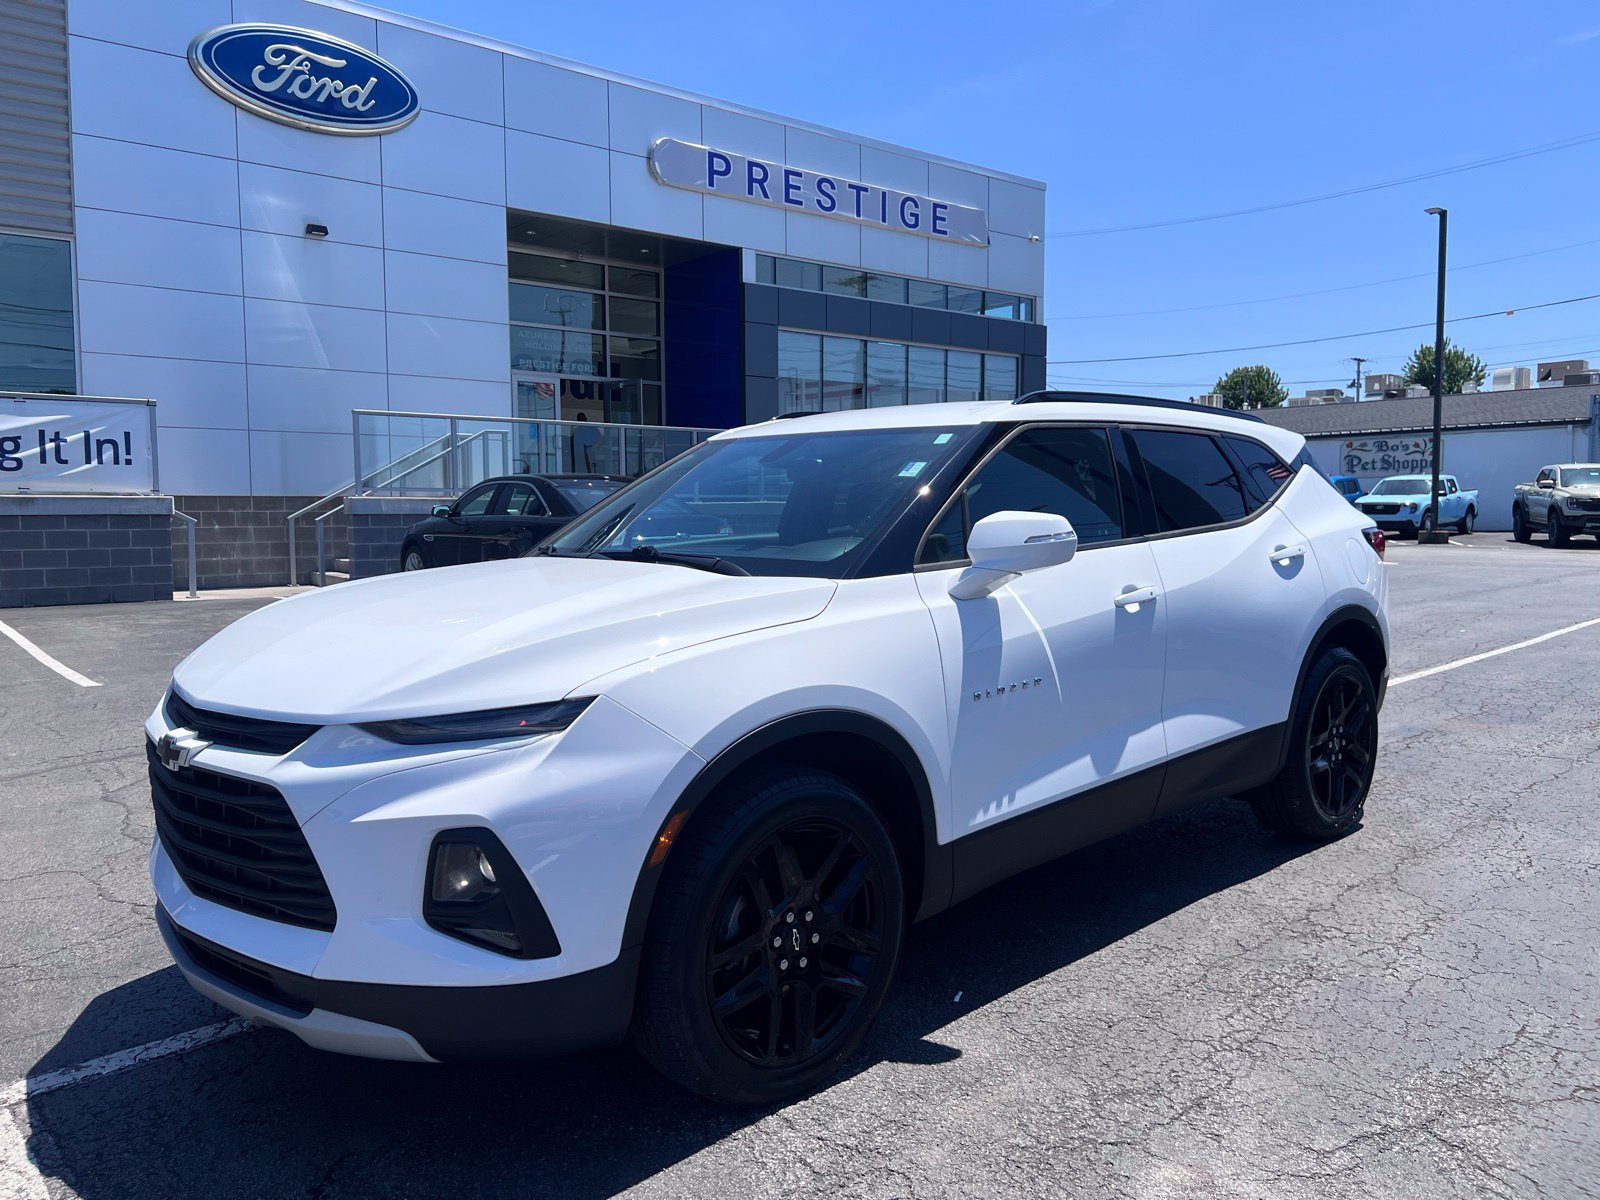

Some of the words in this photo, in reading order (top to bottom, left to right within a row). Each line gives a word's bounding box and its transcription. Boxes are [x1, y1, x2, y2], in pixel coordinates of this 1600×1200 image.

[251, 43, 378, 112] Ford
[706, 150, 949, 236] PRESTIGE
[519, 358, 570, 371] PRESTIGE
[571, 362, 598, 374] FORD
[38, 429, 69, 465] It
[83, 430, 133, 466] In!
[1372, 440, 1410, 453] Bo's
[1343, 454, 1378, 473] Pet
[973, 676, 1042, 702] BLAZER
